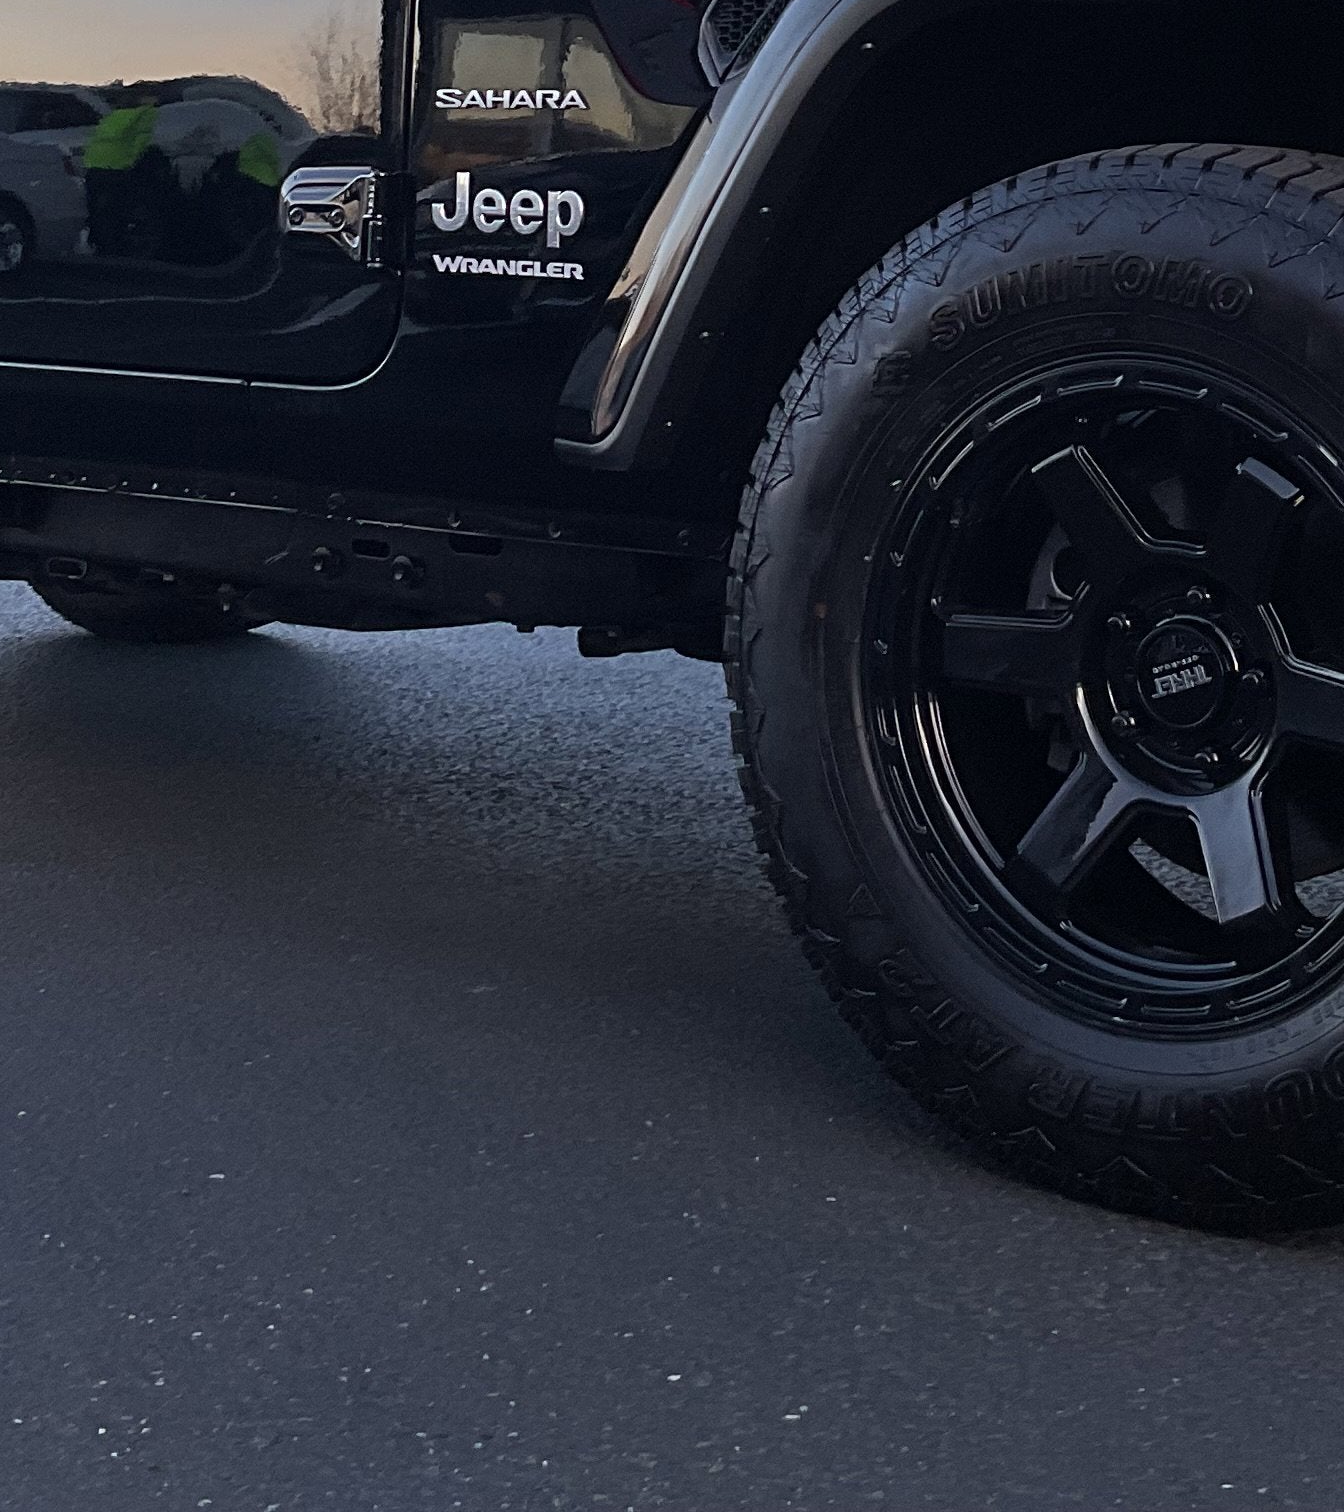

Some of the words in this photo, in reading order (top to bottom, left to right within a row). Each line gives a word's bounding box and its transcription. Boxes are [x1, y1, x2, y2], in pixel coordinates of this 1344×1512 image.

[435, 88, 587, 110] SAHARA
[431, 171, 585, 249] Jeep
[432, 254, 585, 280] WRANGLER
[928, 250, 1255, 352] SUMITOMO
